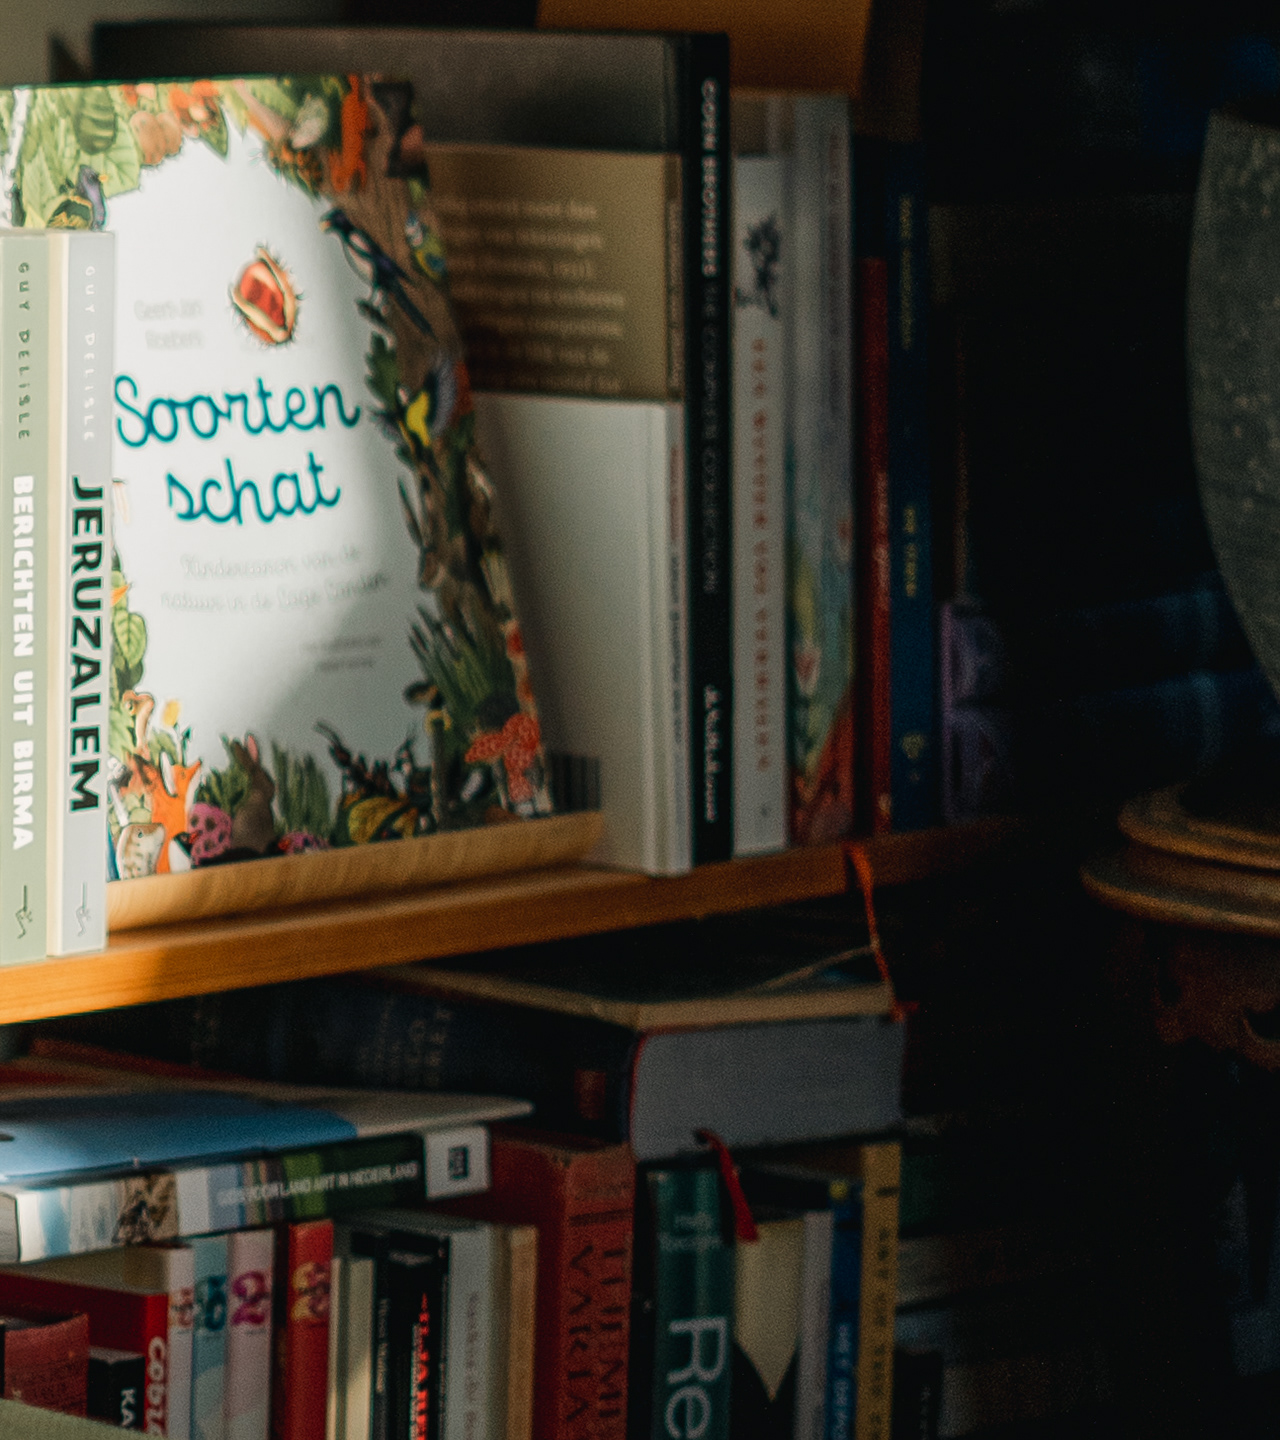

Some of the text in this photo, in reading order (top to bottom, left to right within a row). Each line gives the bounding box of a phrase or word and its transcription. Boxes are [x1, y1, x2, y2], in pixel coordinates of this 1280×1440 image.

[113, 373, 360, 450] Soorten
[166, 456, 343, 526] schat
[11, 474, 35, 852] BERICHTEN UIT BIRMA
[69, 475, 105, 814] JERUZALEM
